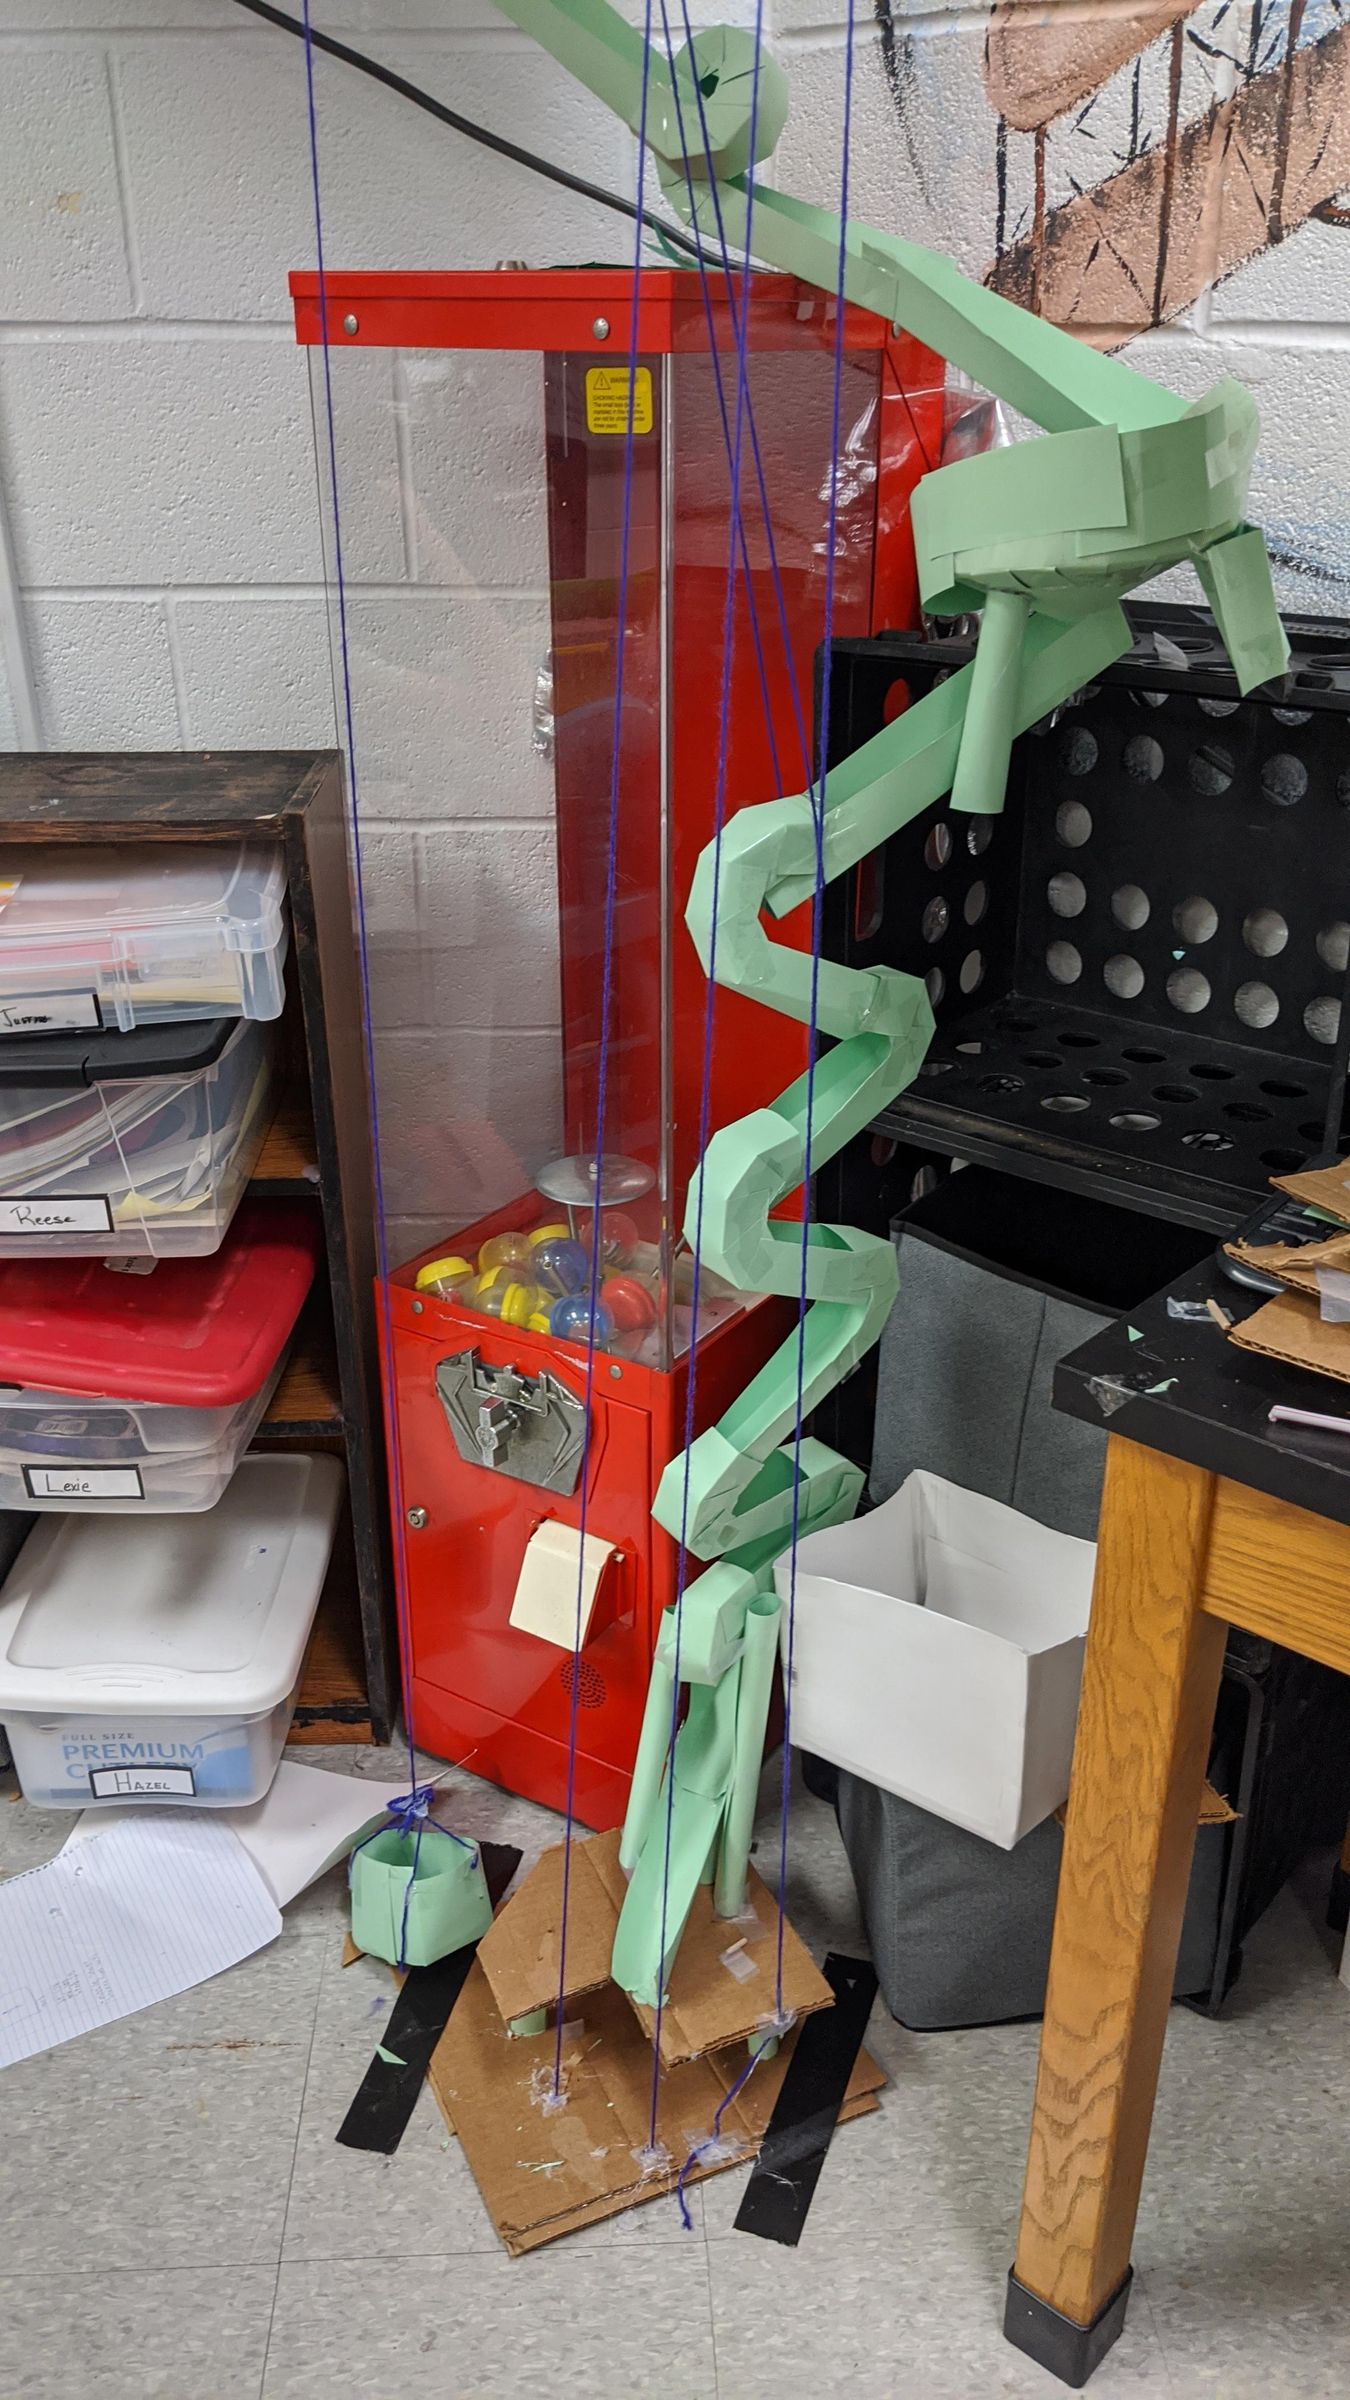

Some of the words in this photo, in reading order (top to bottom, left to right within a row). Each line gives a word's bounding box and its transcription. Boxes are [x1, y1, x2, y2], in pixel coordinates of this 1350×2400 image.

[10, 1205, 77, 1226] Reese
[46, 1473, 92, 1493] Lexie
[62, 1733, 96, 1741] FULL
[102, 1732, 135, 1740] SIZE
[63, 1743, 204, 1760] PREMIUM
